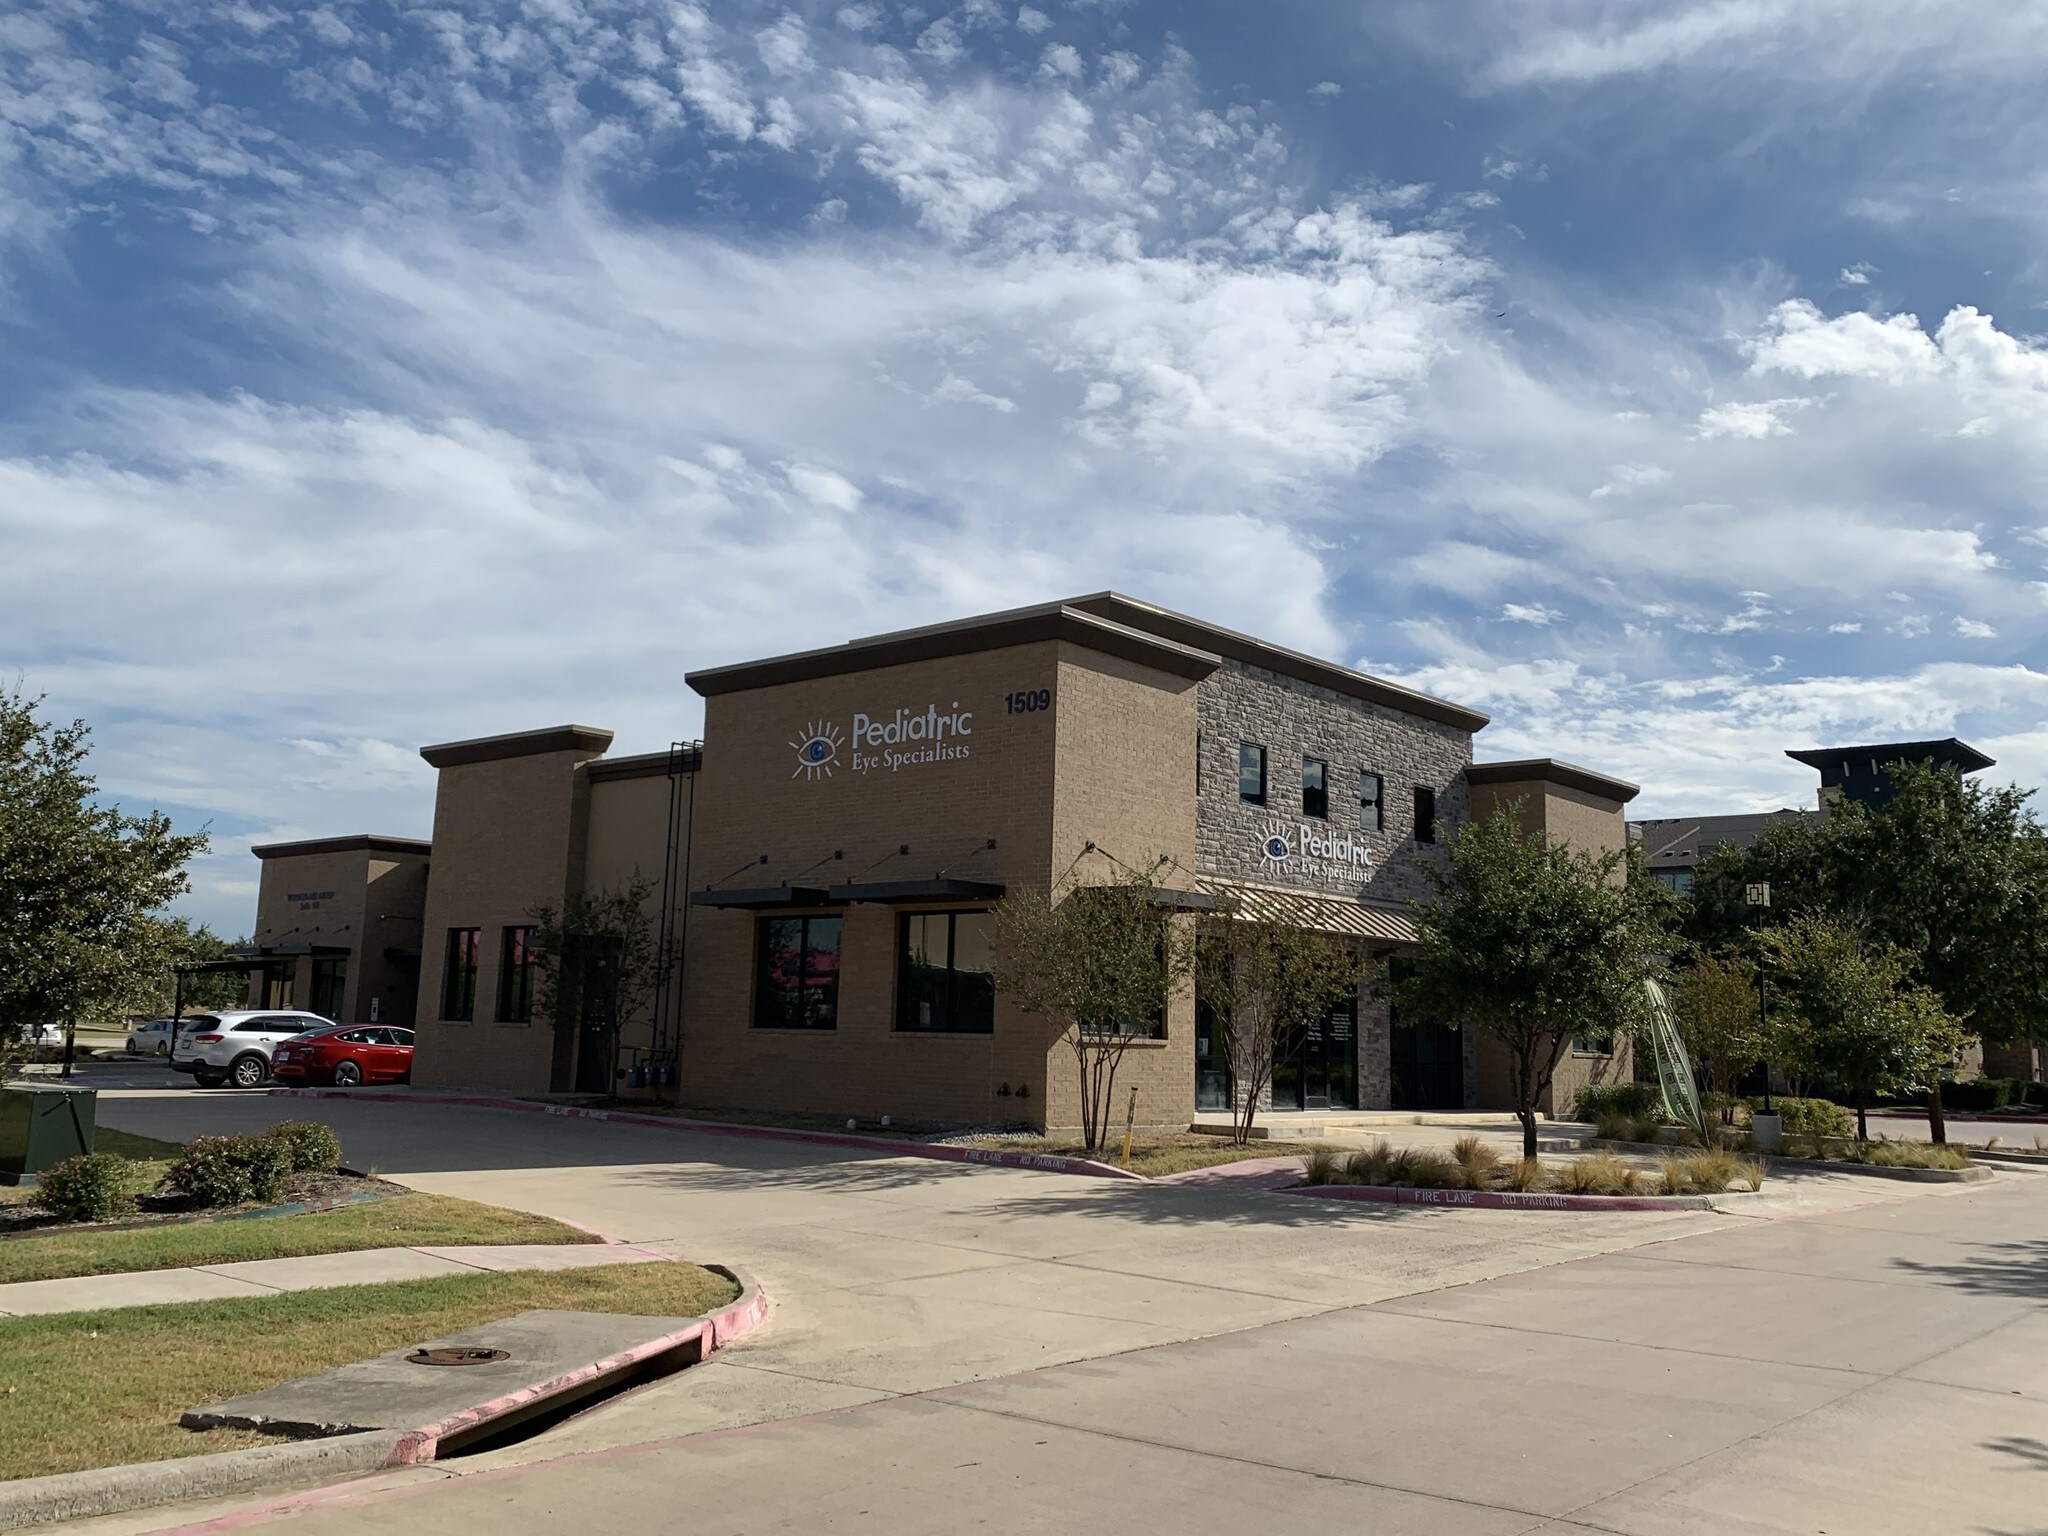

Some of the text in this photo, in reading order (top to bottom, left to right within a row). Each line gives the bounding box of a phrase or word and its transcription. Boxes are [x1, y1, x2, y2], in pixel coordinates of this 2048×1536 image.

[1004, 688, 1050, 714] 1509
[851, 701, 973, 749] Pediatric
[851, 742, 970, 774] Eye Specialists
[1299, 824, 1373, 866] Pediatric
[1301, 857, 1373, 884] Eye Specialists
[964, 1150, 1003, 1163] FIRE LANE
[1019, 1155, 1067, 1169] NO PARKING
[1414, 1190, 1475, 1204] FIRE LANE
[1501, 1194, 1567, 1207] NO PARKING
